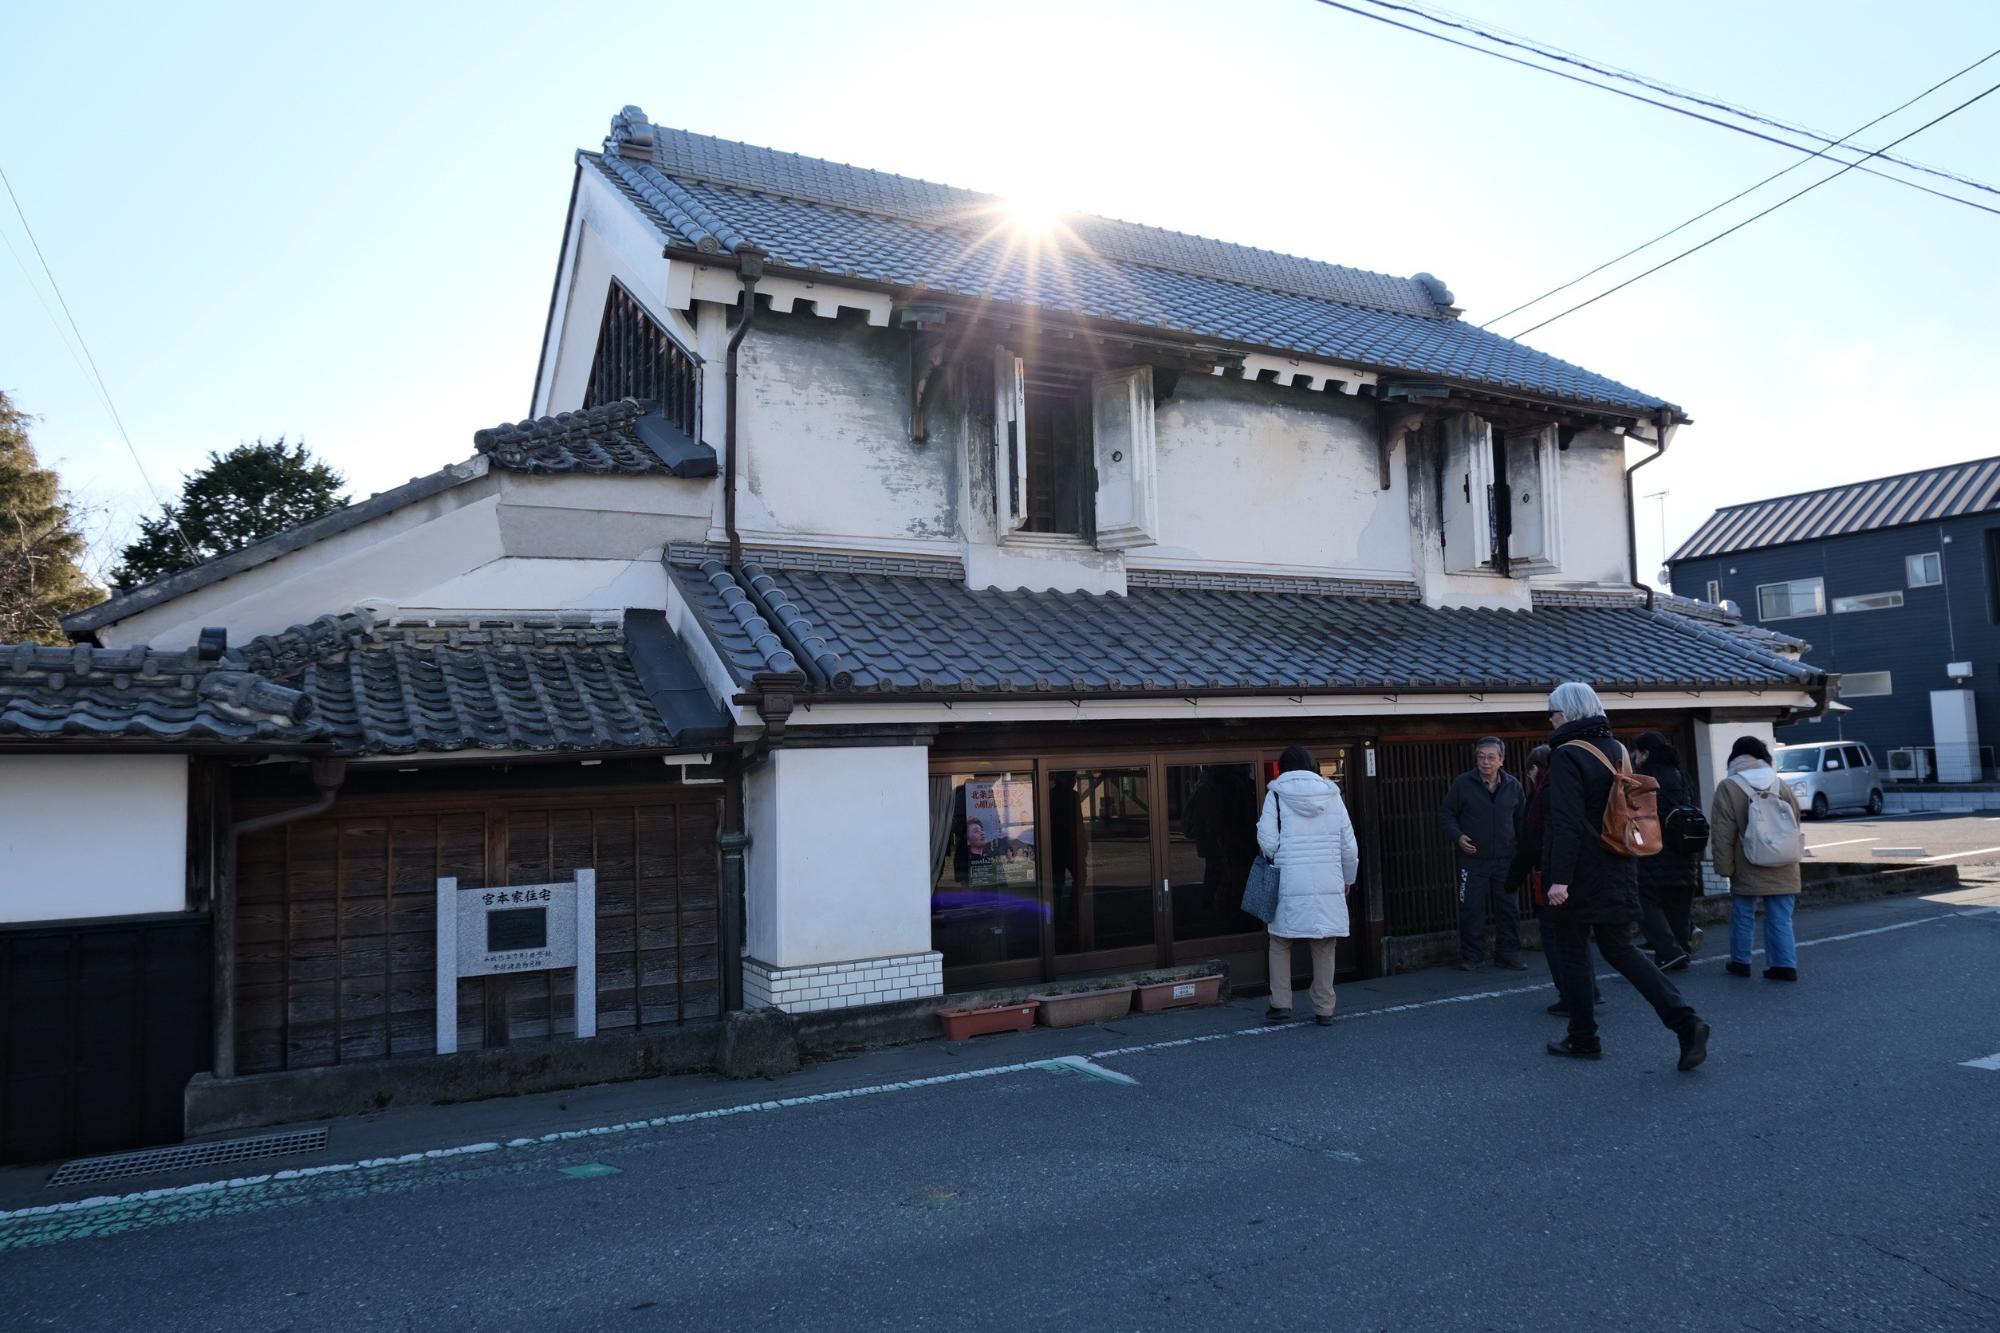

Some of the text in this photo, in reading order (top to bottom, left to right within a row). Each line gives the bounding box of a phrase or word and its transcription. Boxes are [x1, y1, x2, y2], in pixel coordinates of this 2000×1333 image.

[482, 888, 551, 905] 宮本家住宅
